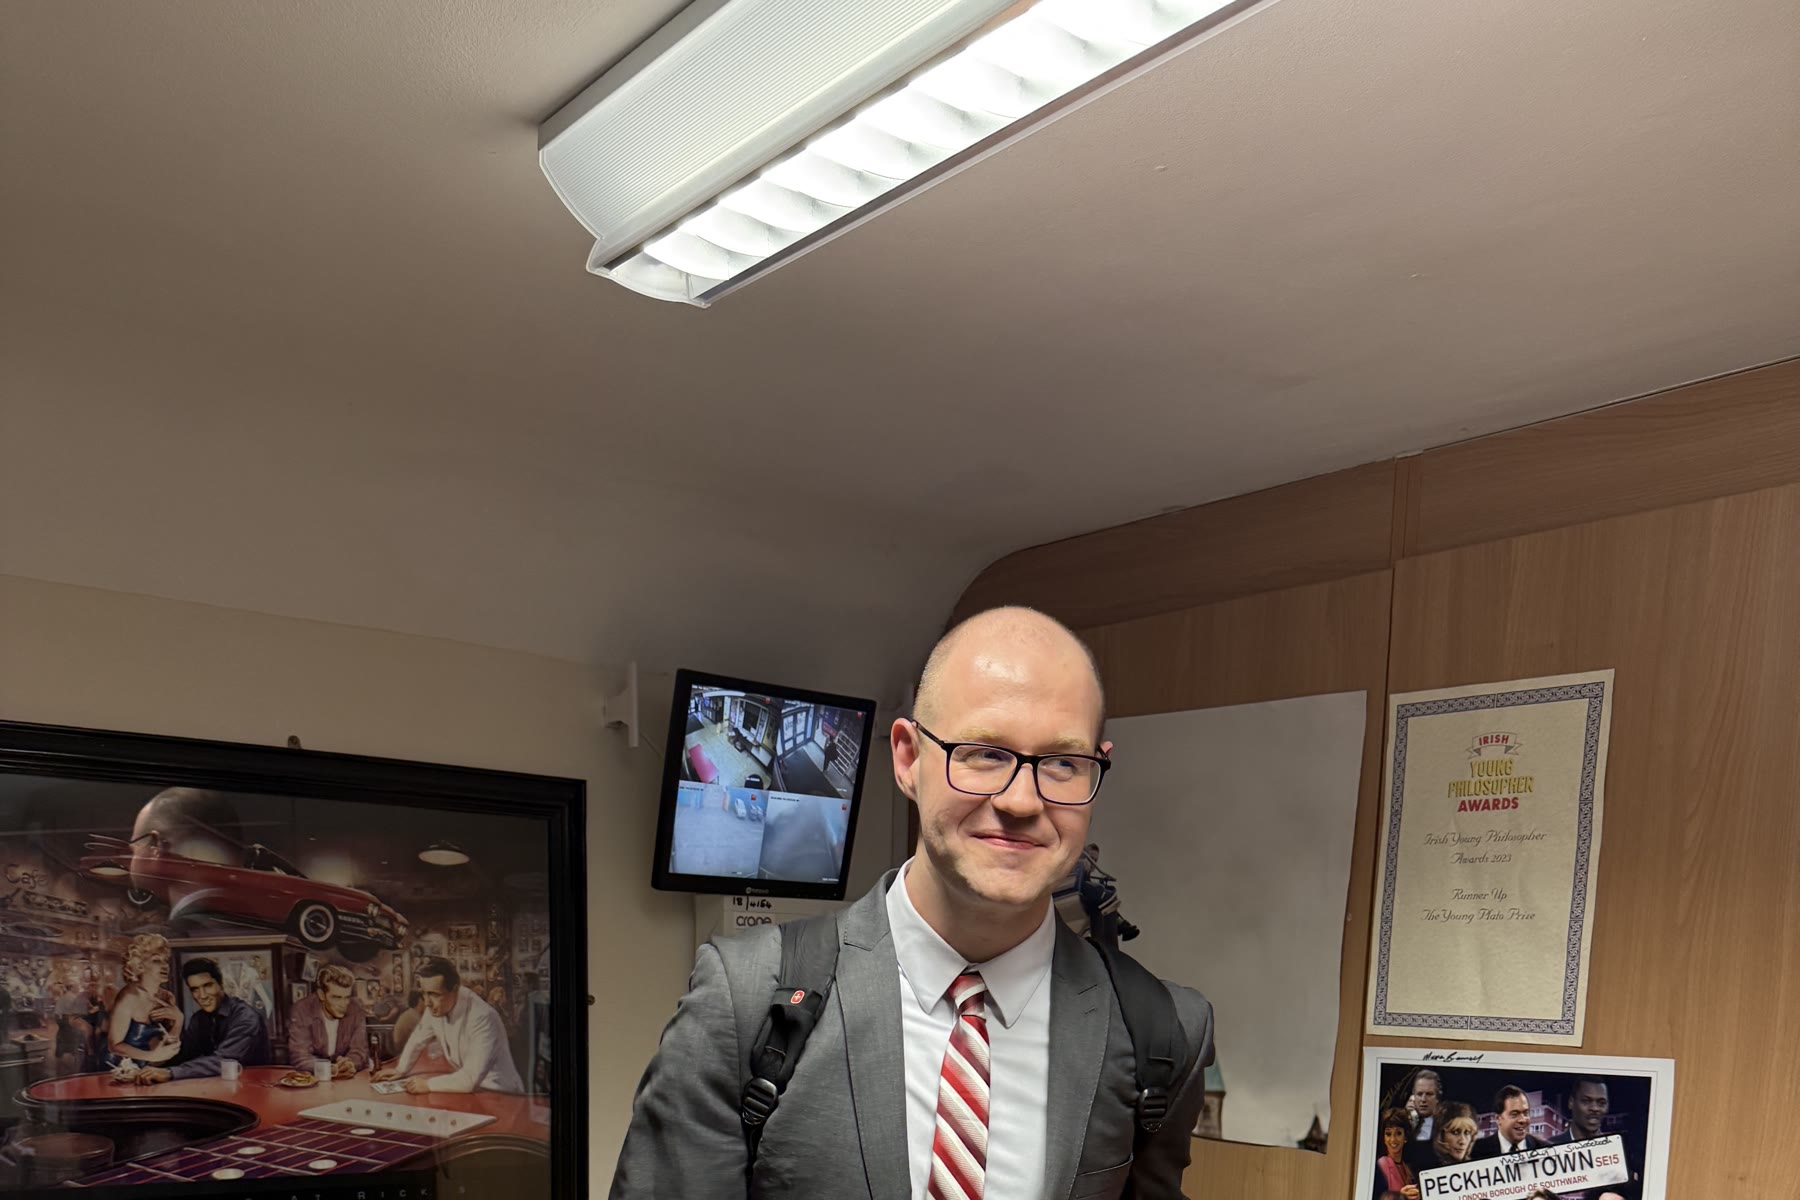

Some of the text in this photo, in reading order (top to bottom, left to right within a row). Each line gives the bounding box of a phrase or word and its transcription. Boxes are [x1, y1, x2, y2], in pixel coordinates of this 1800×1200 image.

[1479, 734, 1510, 746] IRISH
[1470, 759, 1514, 778] YOUNG
[1447, 776, 1535, 798] PHILOSOPHER
[1457, 797, 1519, 812] AWARDS
[1424, 828, 1547, 847] Irish Young Philosopher
[1450, 851, 1512, 865] Awards 2023
[1451, 887, 1508, 902] Runner Up
[1422, 909, 1440, 920] The
[1441, 908, 1475, 924] Young
[1479, 907, 1504, 921] Plato
[1425, 1164, 1522, 1197] PECKHAM
[1531, 1150, 1594, 1179] TOWN
[1595, 1154, 1620, 1168] SE15
[1489, 1185, 1526, 1197] BOROUGH
[1527, 1182, 1538, 1191] OF
[1539, 1175, 1588, 1190] SOUTHWARK
